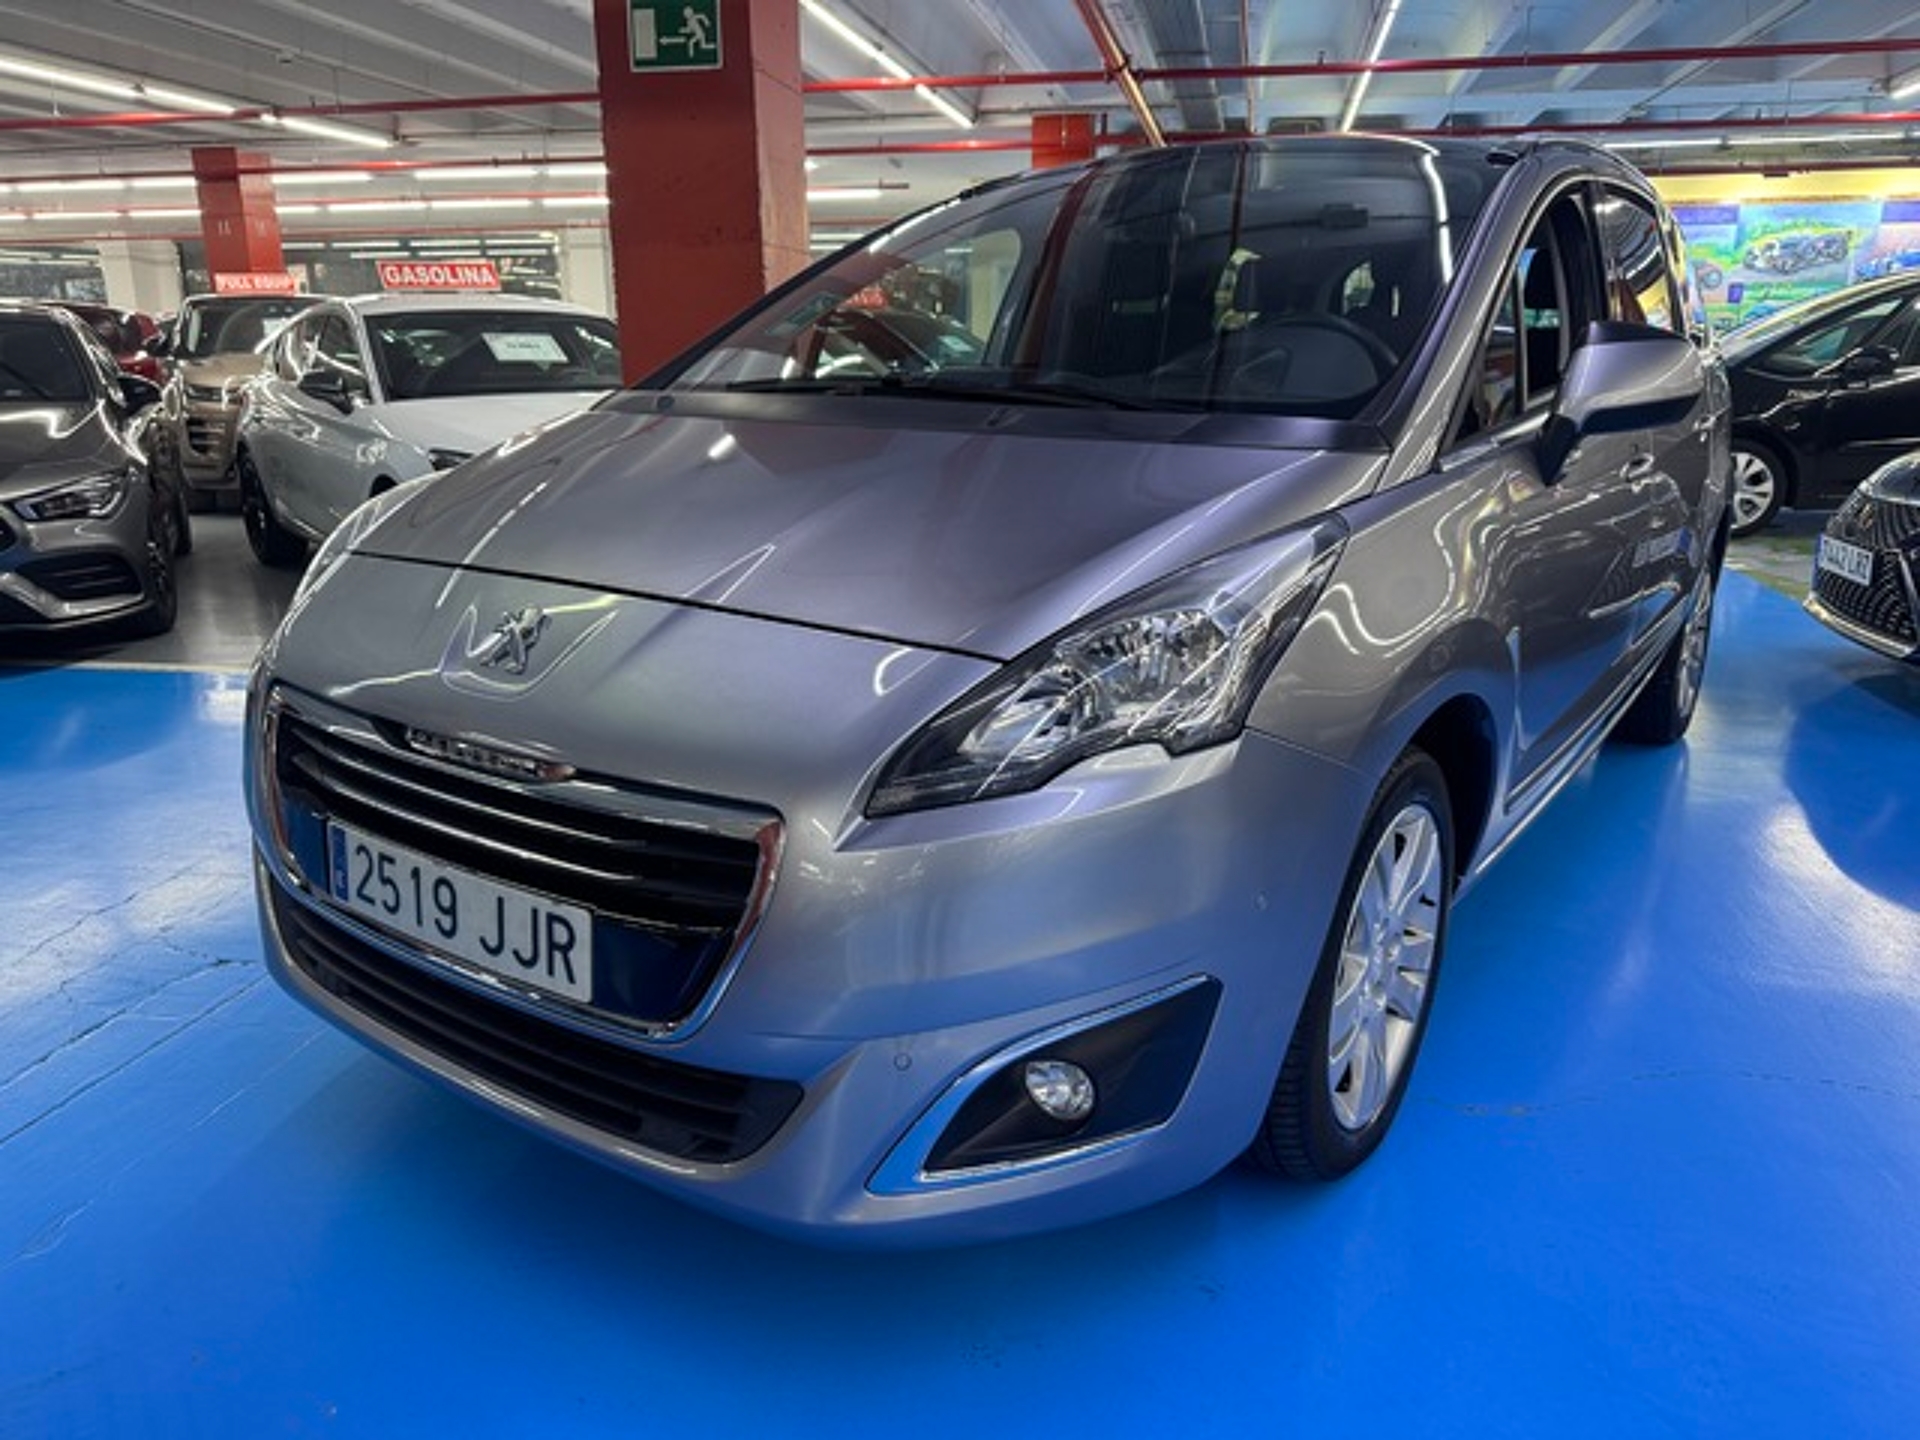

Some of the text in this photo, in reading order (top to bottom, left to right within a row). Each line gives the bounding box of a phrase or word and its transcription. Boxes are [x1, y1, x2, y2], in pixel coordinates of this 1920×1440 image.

[384, 265, 496, 286] GASOLINA
[356, 843, 577, 985] 2519 JJR
